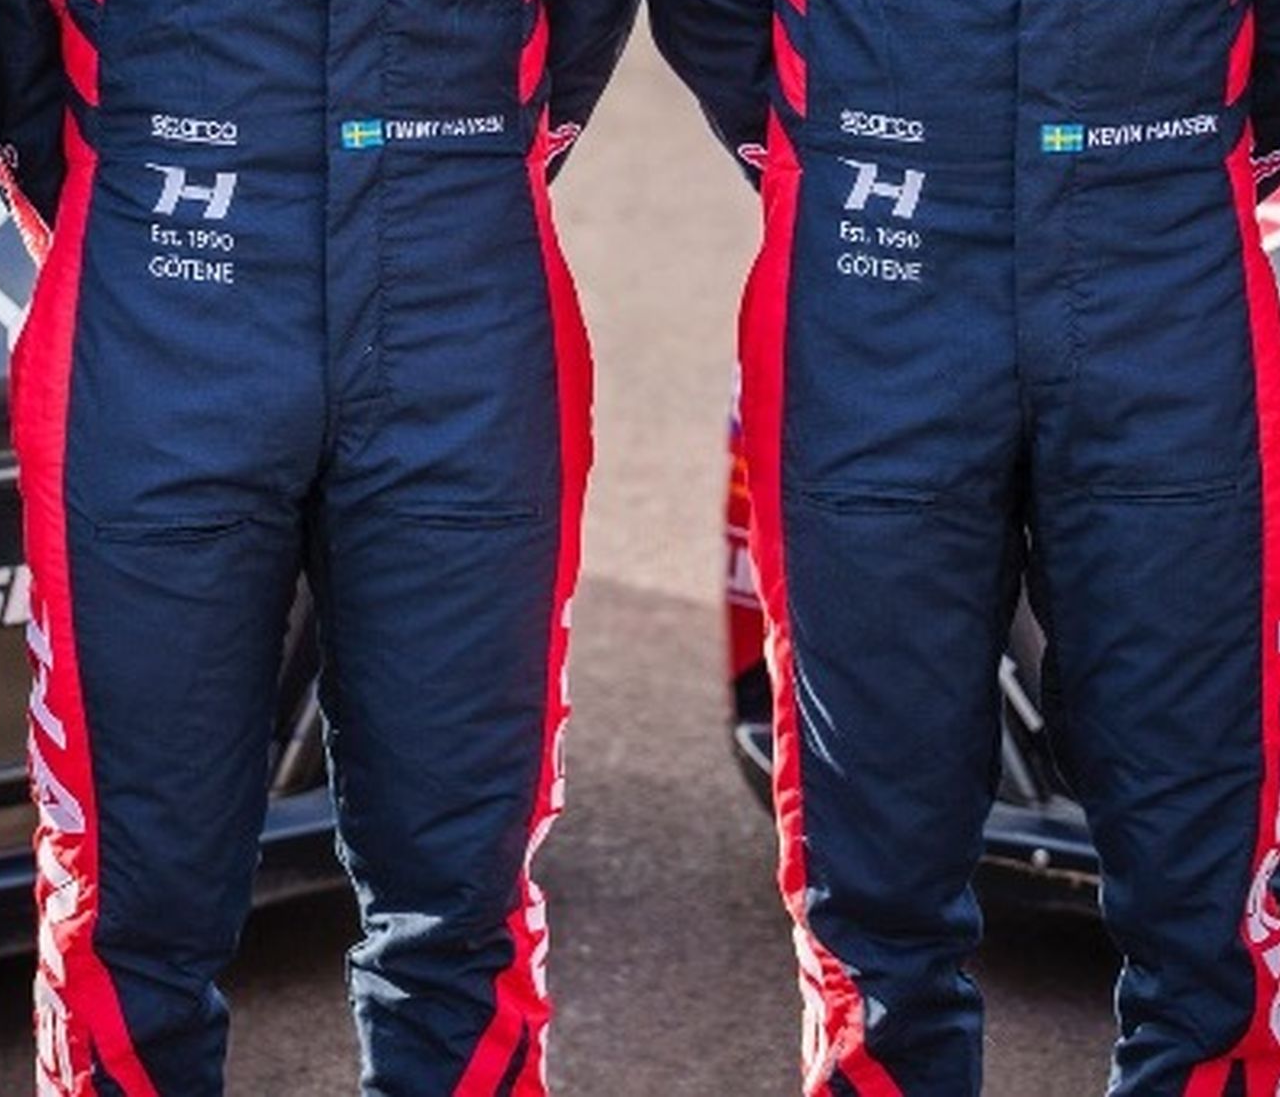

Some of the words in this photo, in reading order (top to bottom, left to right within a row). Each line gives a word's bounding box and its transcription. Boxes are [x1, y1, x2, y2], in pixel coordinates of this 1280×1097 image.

[151, 114, 237, 145] sparco
[840, 108, 925, 142] sparco
[1087, 124, 1143, 147] KEVIN
[1145, 114, 1217, 141] HANSEN
[187, 229, 234, 251] 1990
[876, 226, 922, 250] 1990
[148, 253, 234, 284] GÖTENE
